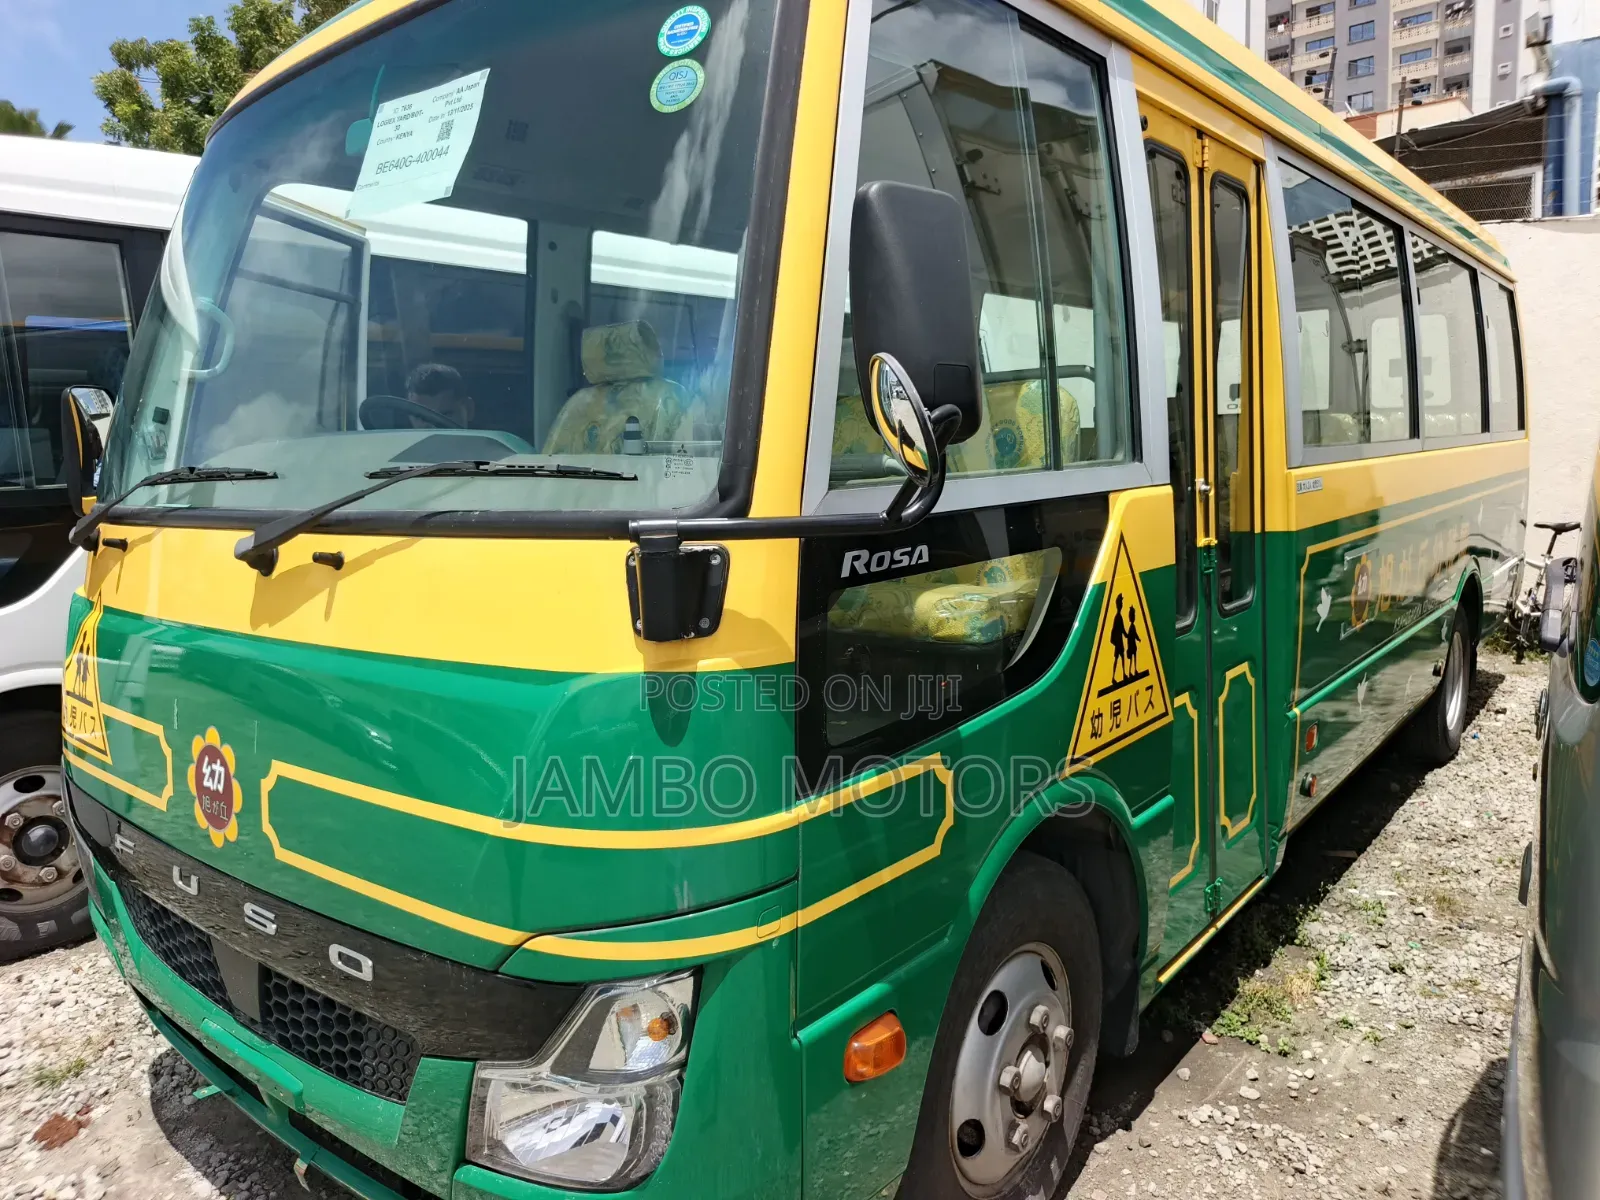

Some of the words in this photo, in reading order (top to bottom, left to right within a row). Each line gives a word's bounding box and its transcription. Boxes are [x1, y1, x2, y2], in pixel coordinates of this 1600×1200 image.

[396, 130, 413, 140] KENYA
[375, 145, 451, 175] BE640G-400044
[1089, 684, 1156, 740] 幼児バス
[202, 754, 226, 795] 幼
[114, 832, 375, 983] FUSO
